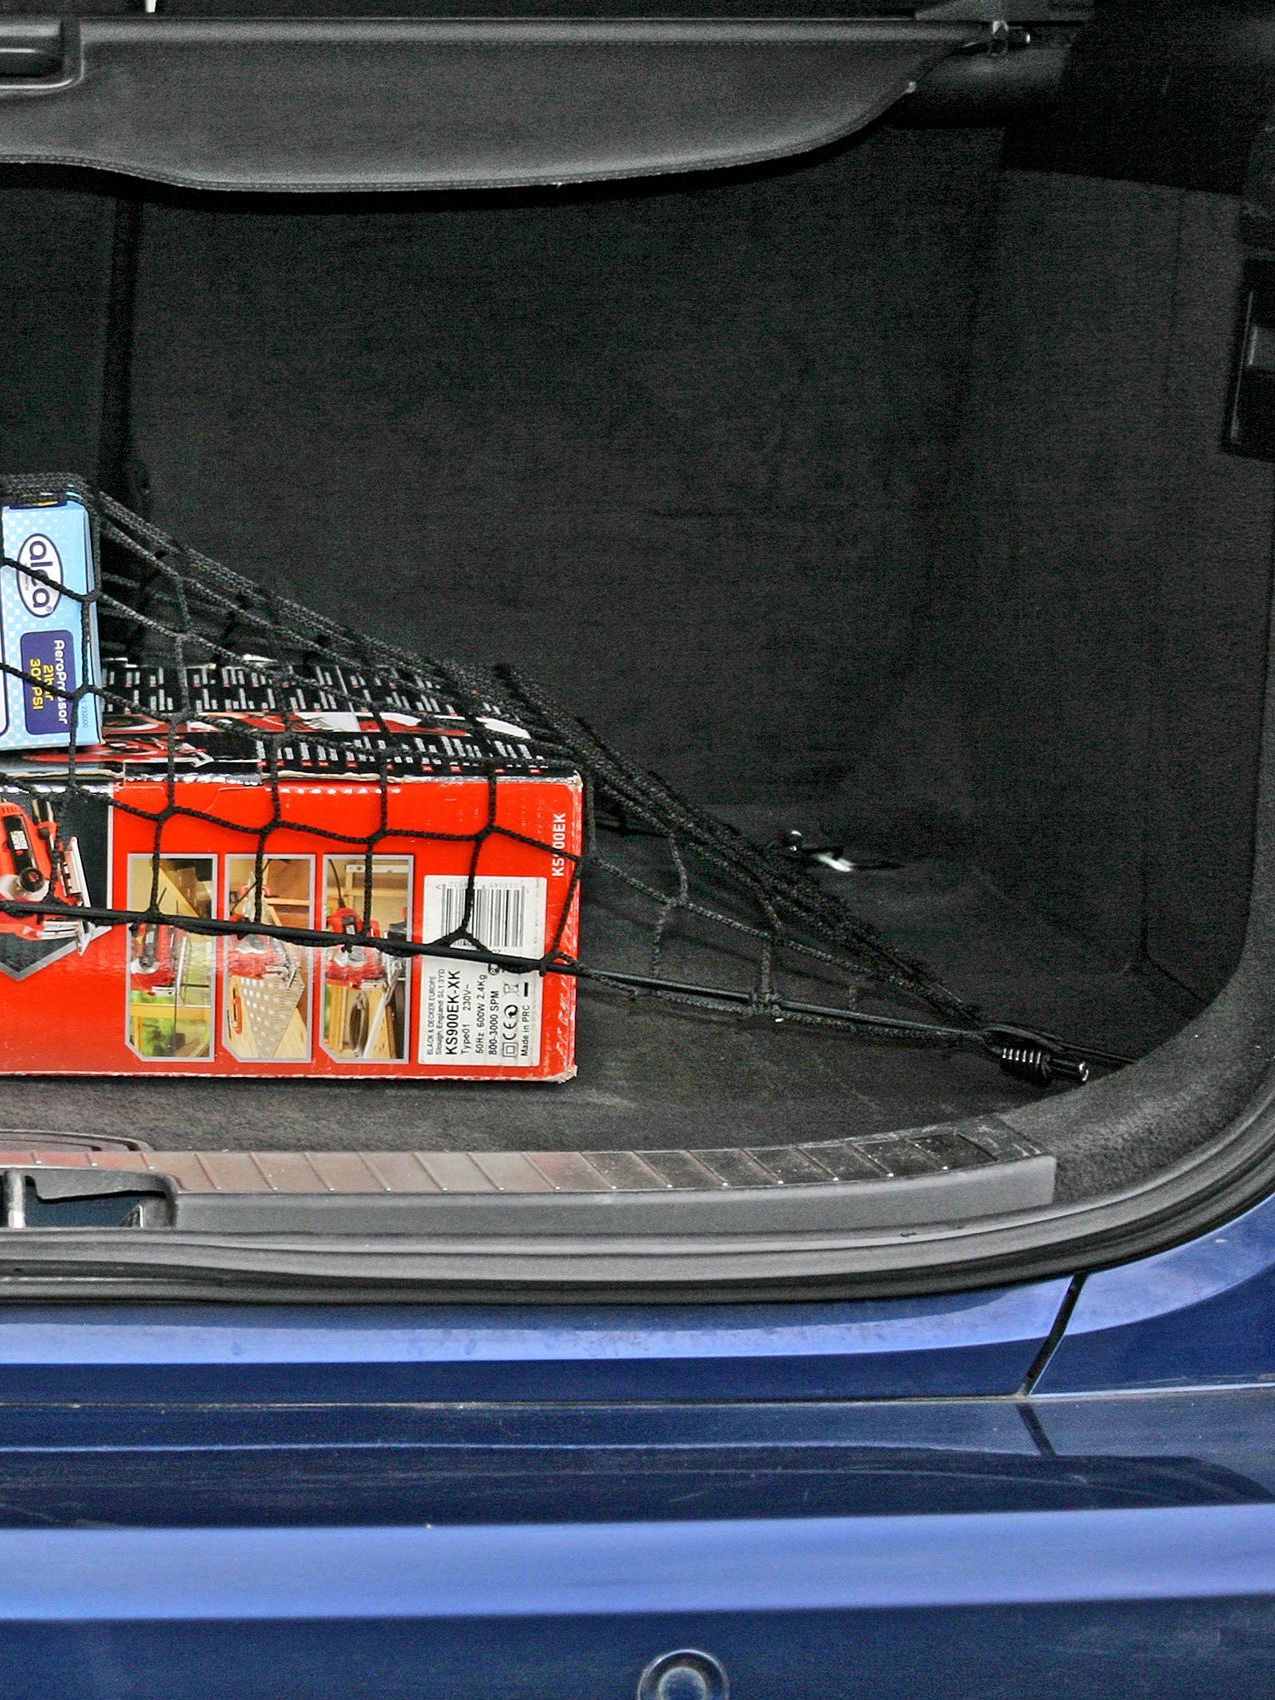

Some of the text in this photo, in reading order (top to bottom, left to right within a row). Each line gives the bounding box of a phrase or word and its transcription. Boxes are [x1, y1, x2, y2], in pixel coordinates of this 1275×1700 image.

[30, 658, 44, 709] 30 PSI
[551, 813, 566, 877] KS00EK
[428, 976, 436, 1001] EUROPE
[427, 1002, 435, 1027] DECKER
[436, 1000, 445, 1029] England
[445, 970, 461, 1055] KS900EK-XK
[476, 1002, 485, 1028] 600W
[488, 990, 499, 1055] 800-3000 SPM
[461, 1024, 472, 1055] Type01
[475, 1032, 485, 1054] 50Hz
[520, 1005, 530, 1057] Made in PRC
